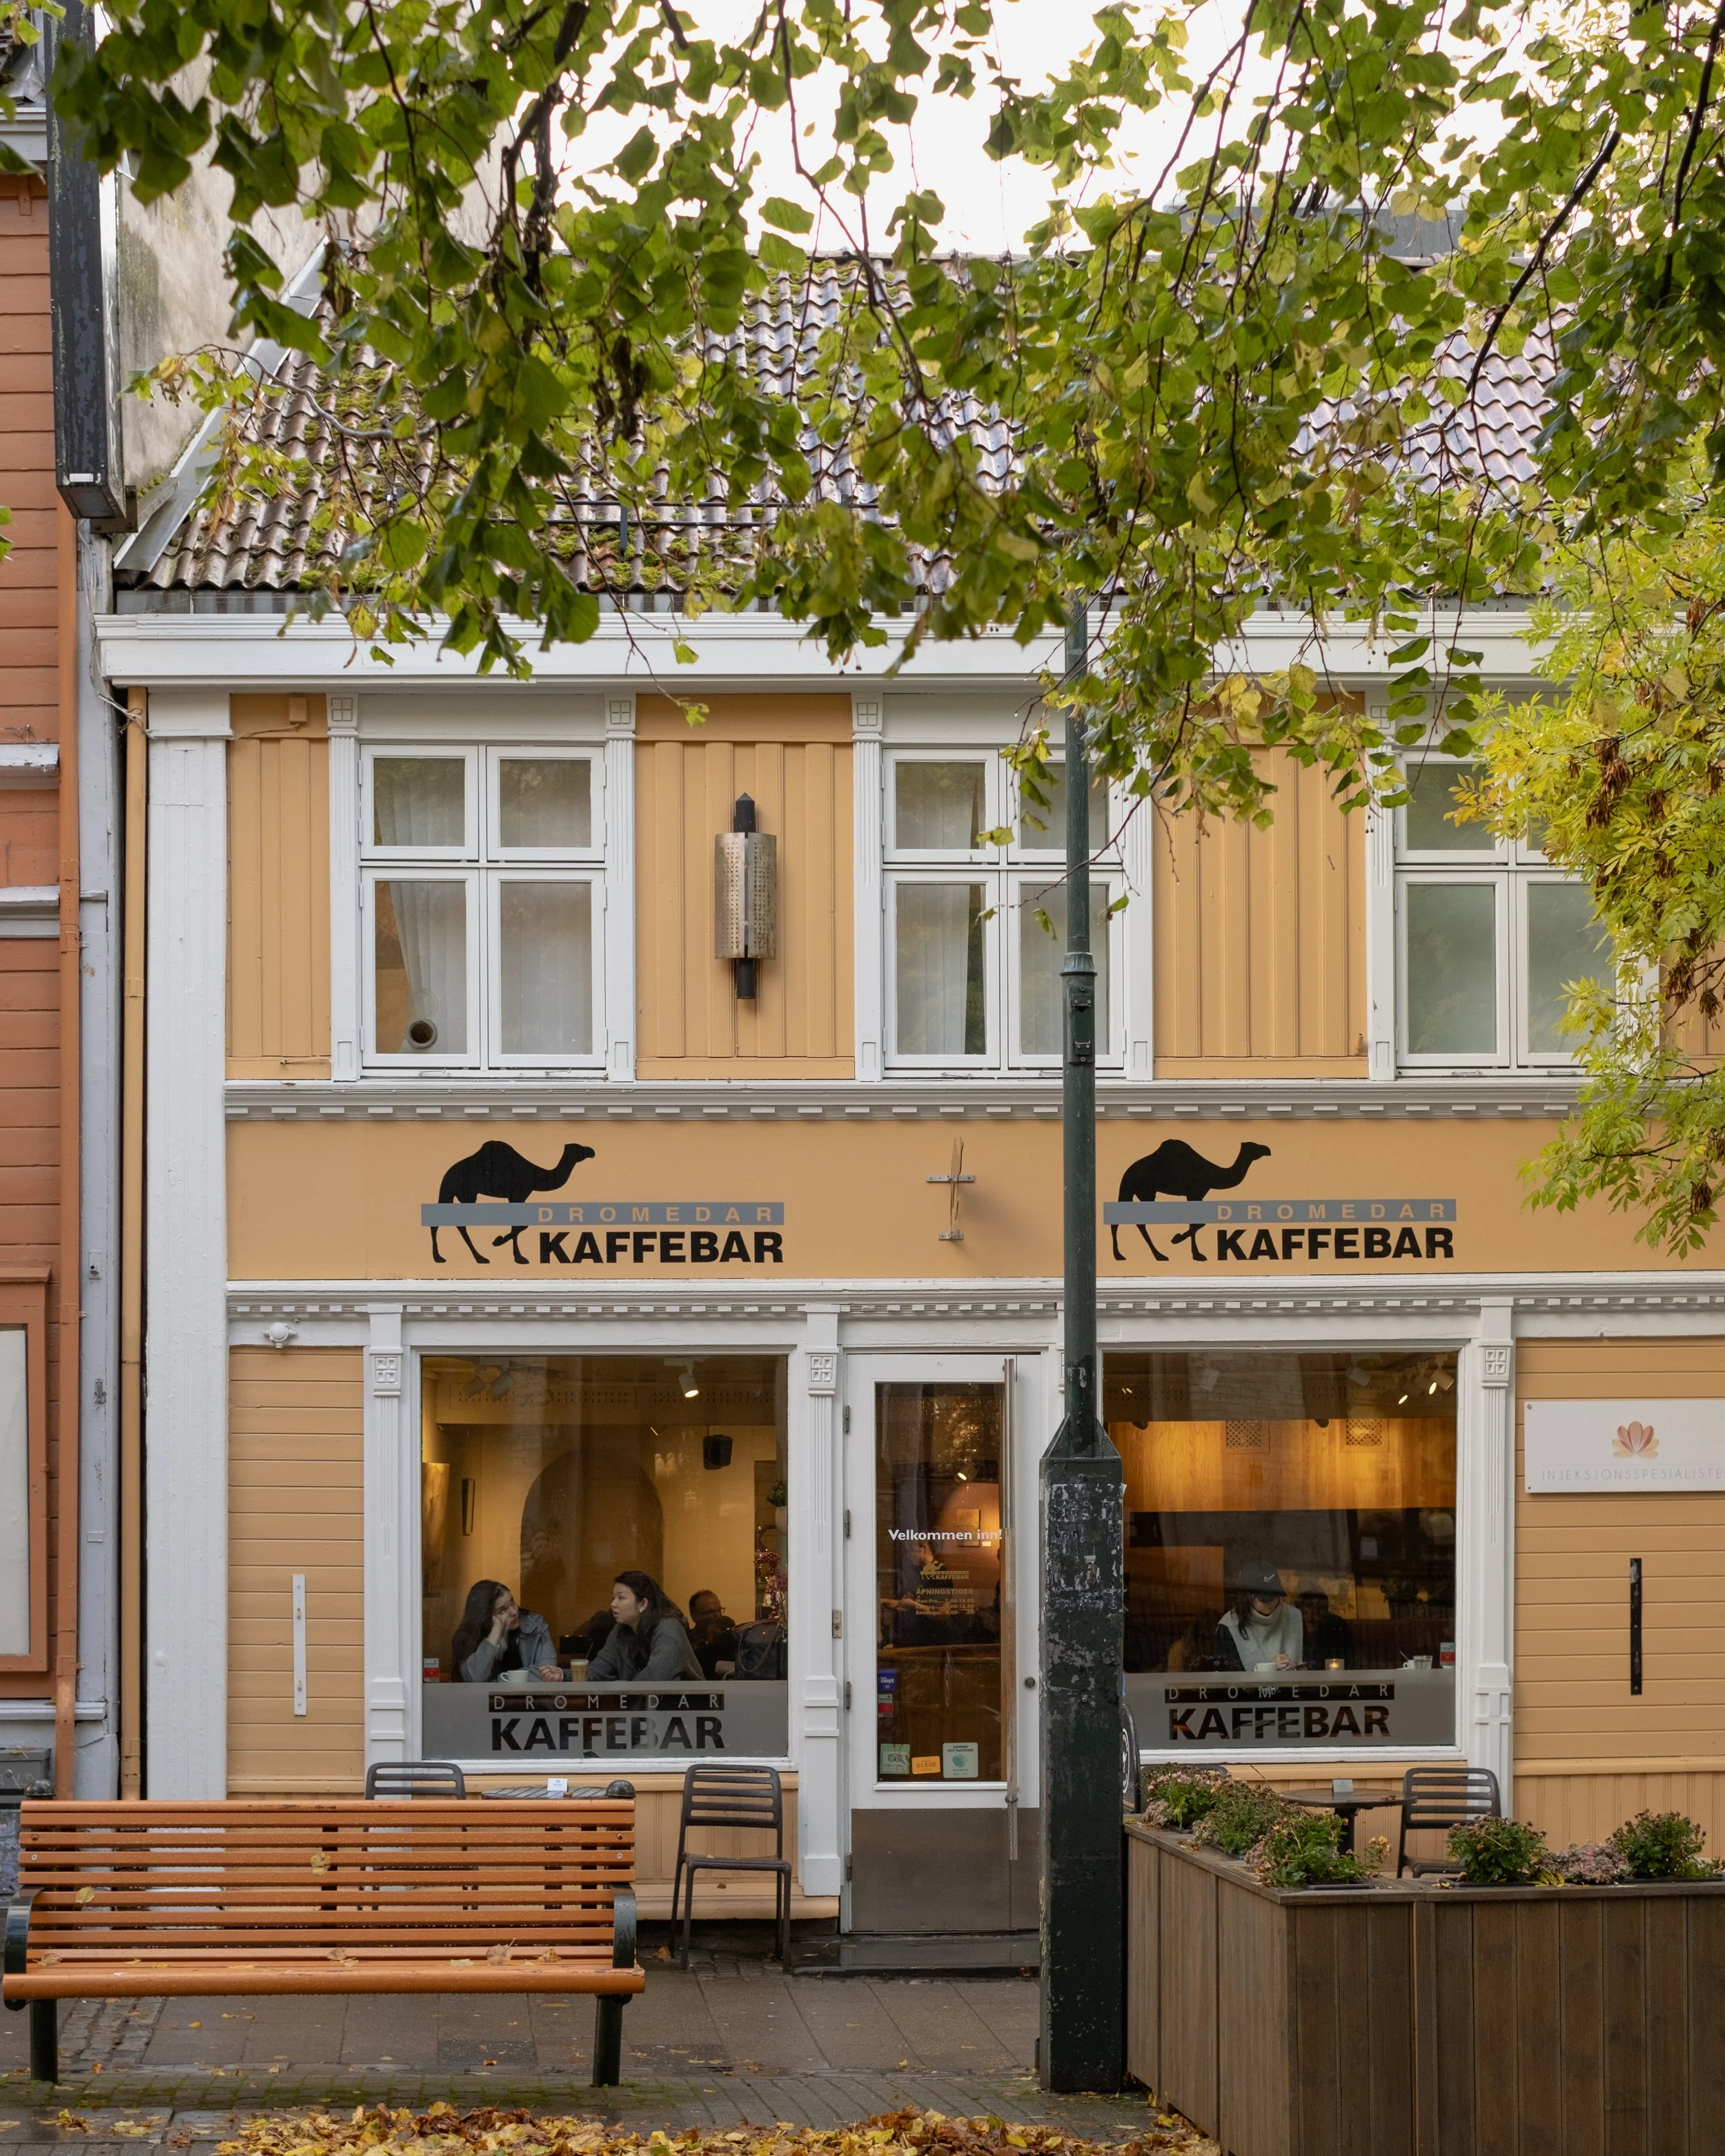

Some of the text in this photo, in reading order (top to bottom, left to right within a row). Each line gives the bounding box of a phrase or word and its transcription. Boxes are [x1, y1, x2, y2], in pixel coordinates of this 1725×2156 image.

[538, 1207, 771, 1223] DROMEDAR
[1218, 1203, 1444, 1220] DROMEDAR
[540, 1231, 783, 1263] KAFFEBAR
[1217, 1227, 1454, 1260] KAFFEBAR
[888, 1529, 1003, 1541] Velkommen inn!
[1170, 1683, 1388, 1699] DROMEDAR
[494, 1694, 720, 1710] DROMEDAR
[1169, 1705, 1391, 1740] KAFFEBAR
[492, 1716, 724, 1750] KAFFEBAR
